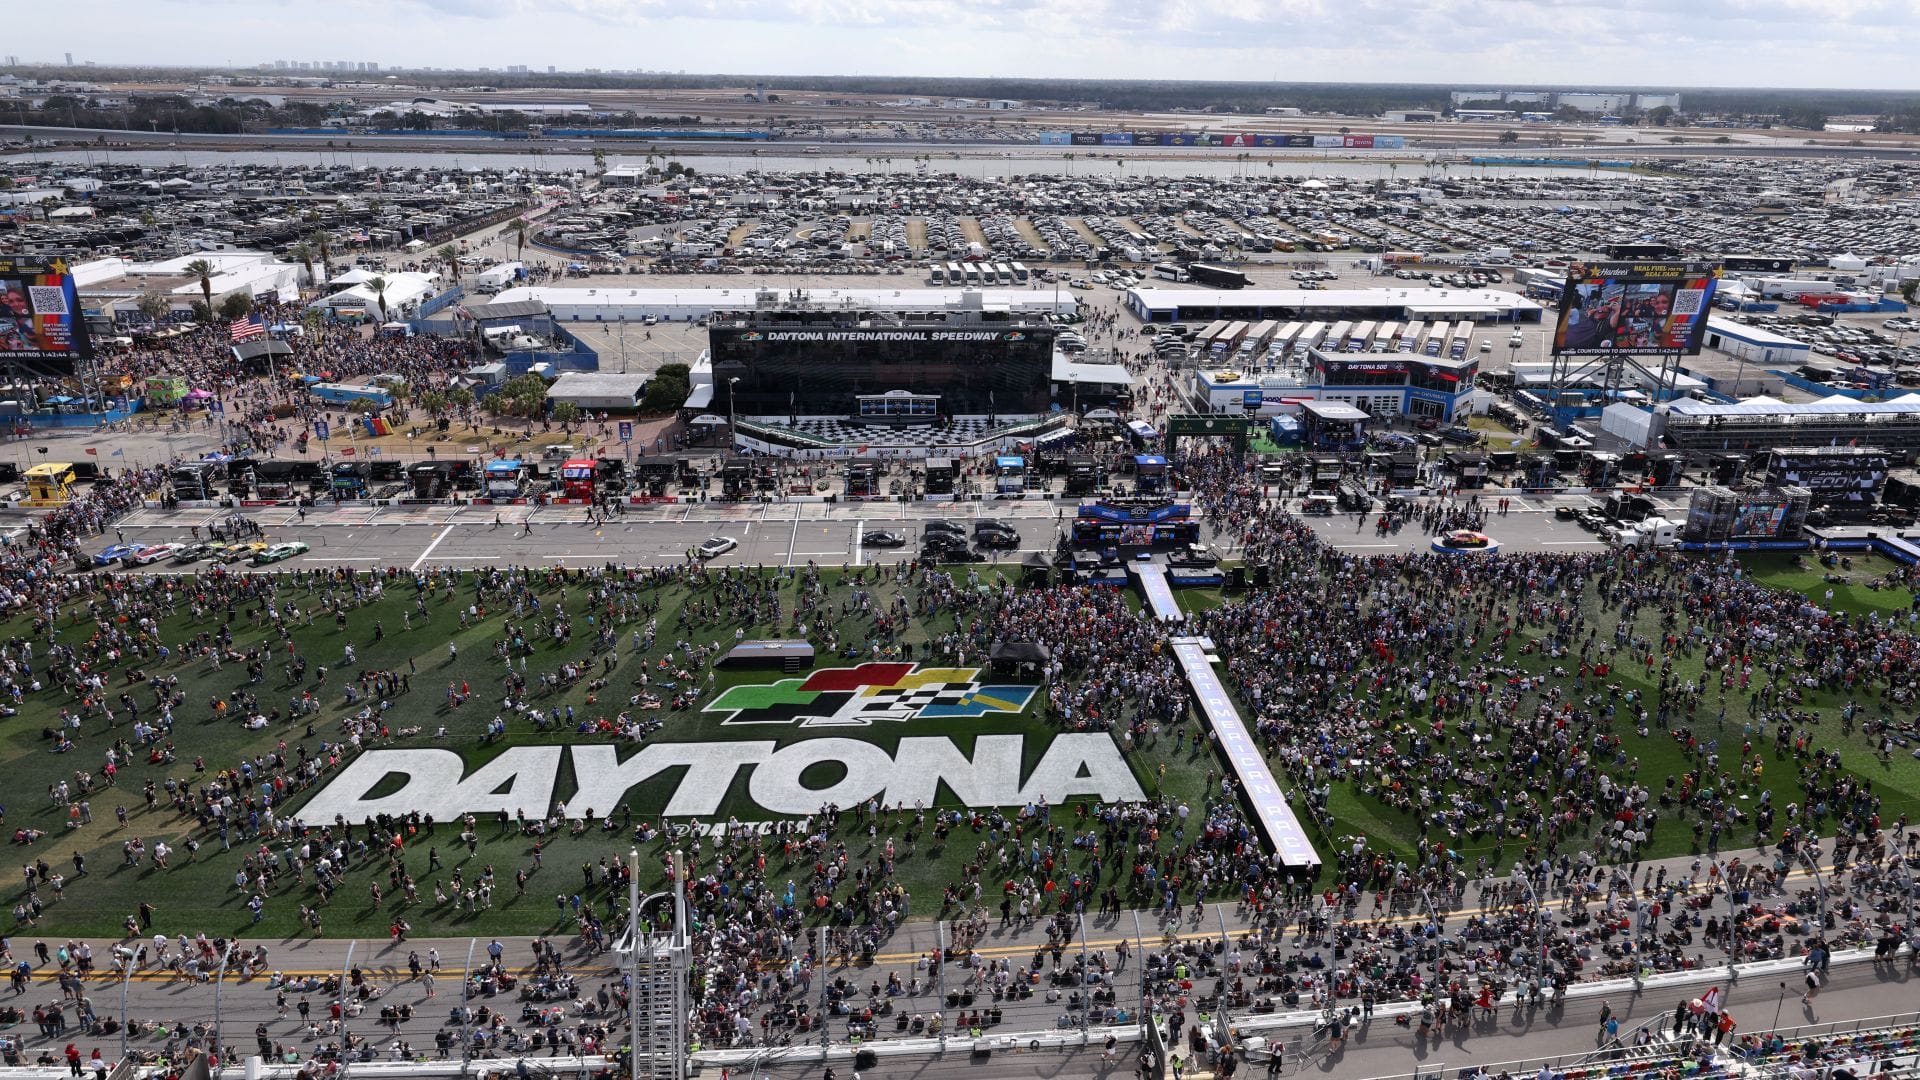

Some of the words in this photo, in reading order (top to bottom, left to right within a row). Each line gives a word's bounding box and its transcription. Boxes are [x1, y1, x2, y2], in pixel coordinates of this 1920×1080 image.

[1598, 268, 1629, 277] Hardee's
[768, 332, 824, 341] DAYTONA
[827, 332, 927, 341] INTERNATIONAL
[931, 332, 999, 341] SPEEDWAY
[1809, 476, 1848, 488] 500
[1208, 698, 1272, 794] AMERICAN
[293, 731, 1148, 827] DAYTONA
[1266, 806, 1308, 864] RACE
